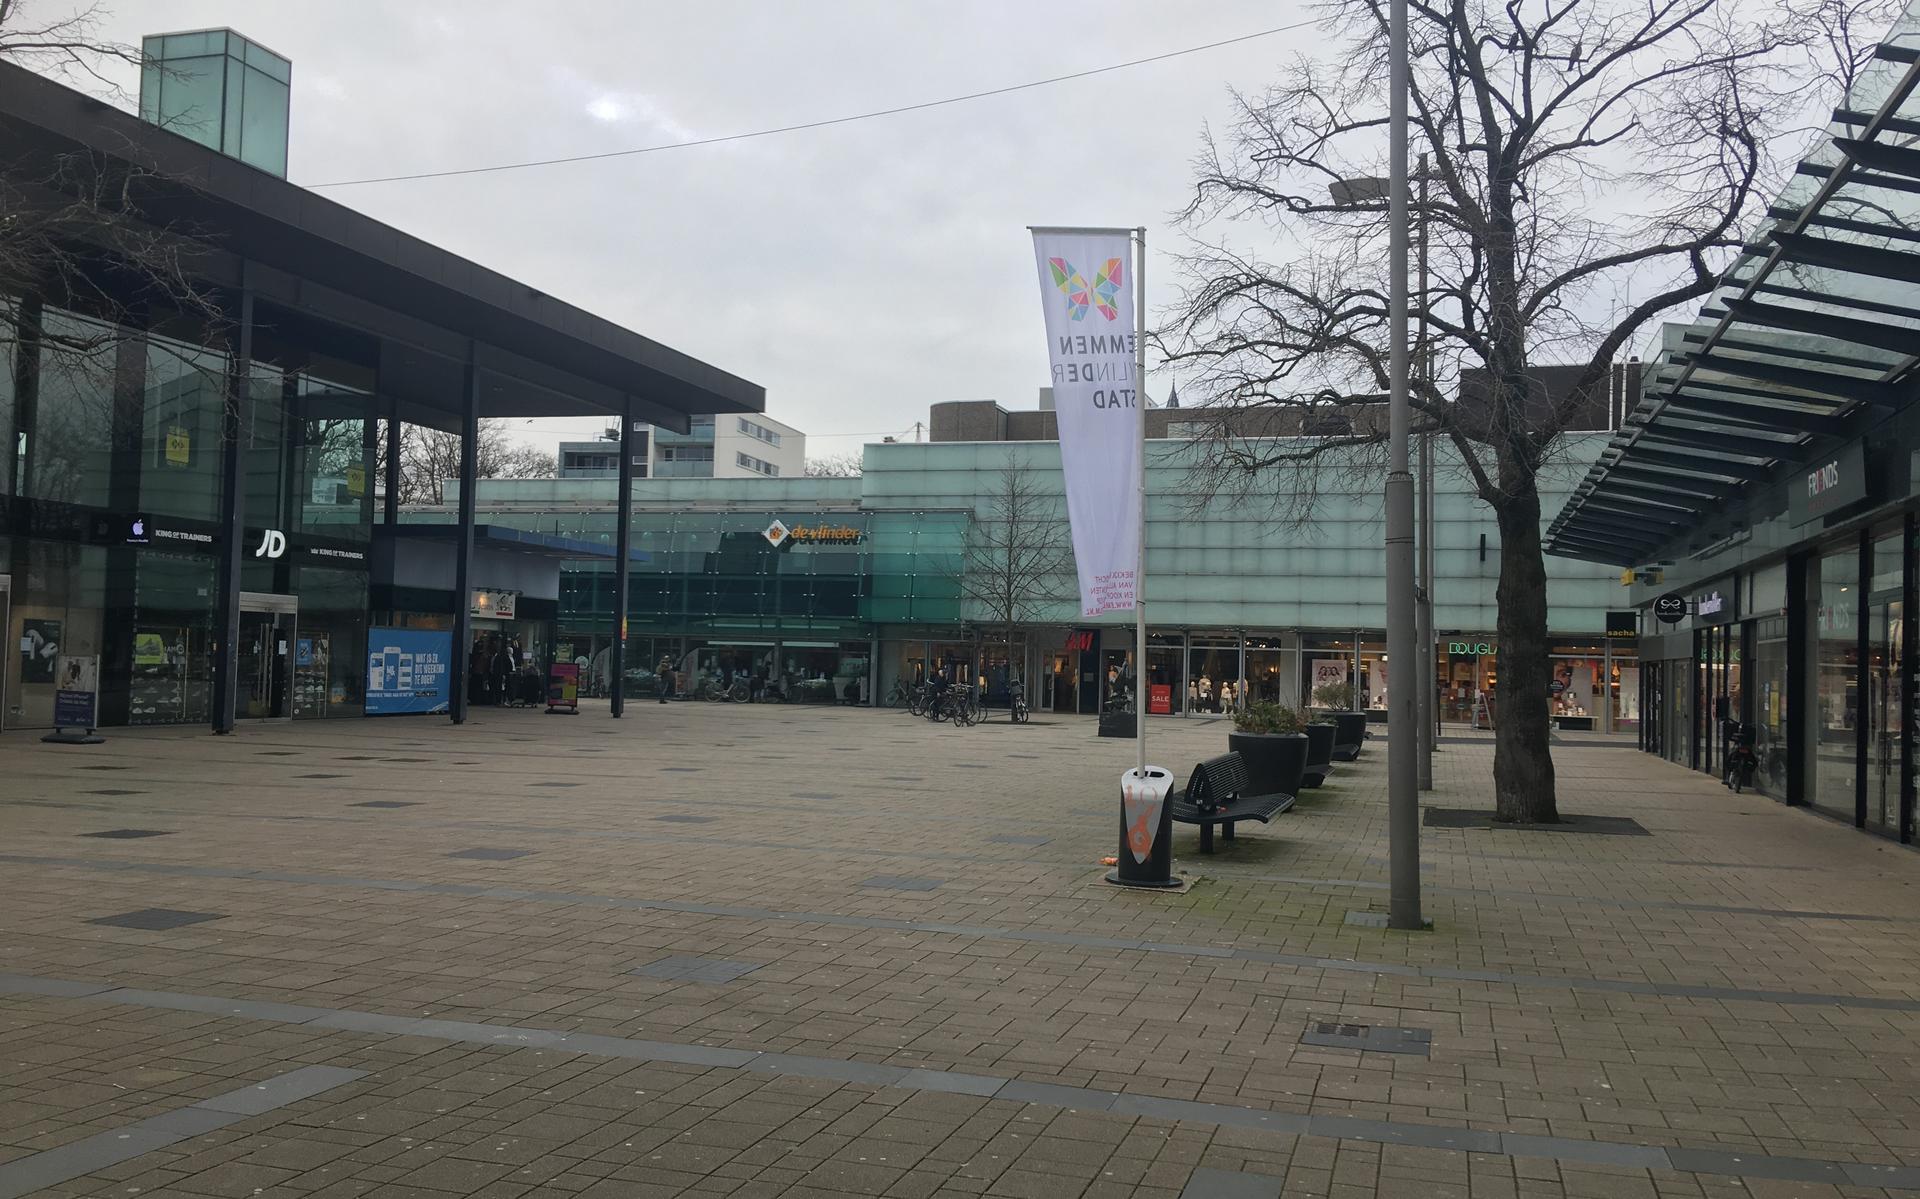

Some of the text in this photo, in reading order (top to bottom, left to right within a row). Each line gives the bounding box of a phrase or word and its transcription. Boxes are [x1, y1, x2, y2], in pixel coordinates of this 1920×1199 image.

[155, 529, 172, 538] KING
[180, 532, 212, 543] TRAINERS
[255, 529, 286, 558] JD
[319, 548, 333, 556] KING
[337, 550, 364, 560] TRAINERS
[1607, 629, 1635, 637] sacha
[423, 664, 445, 674] WEEKEND
